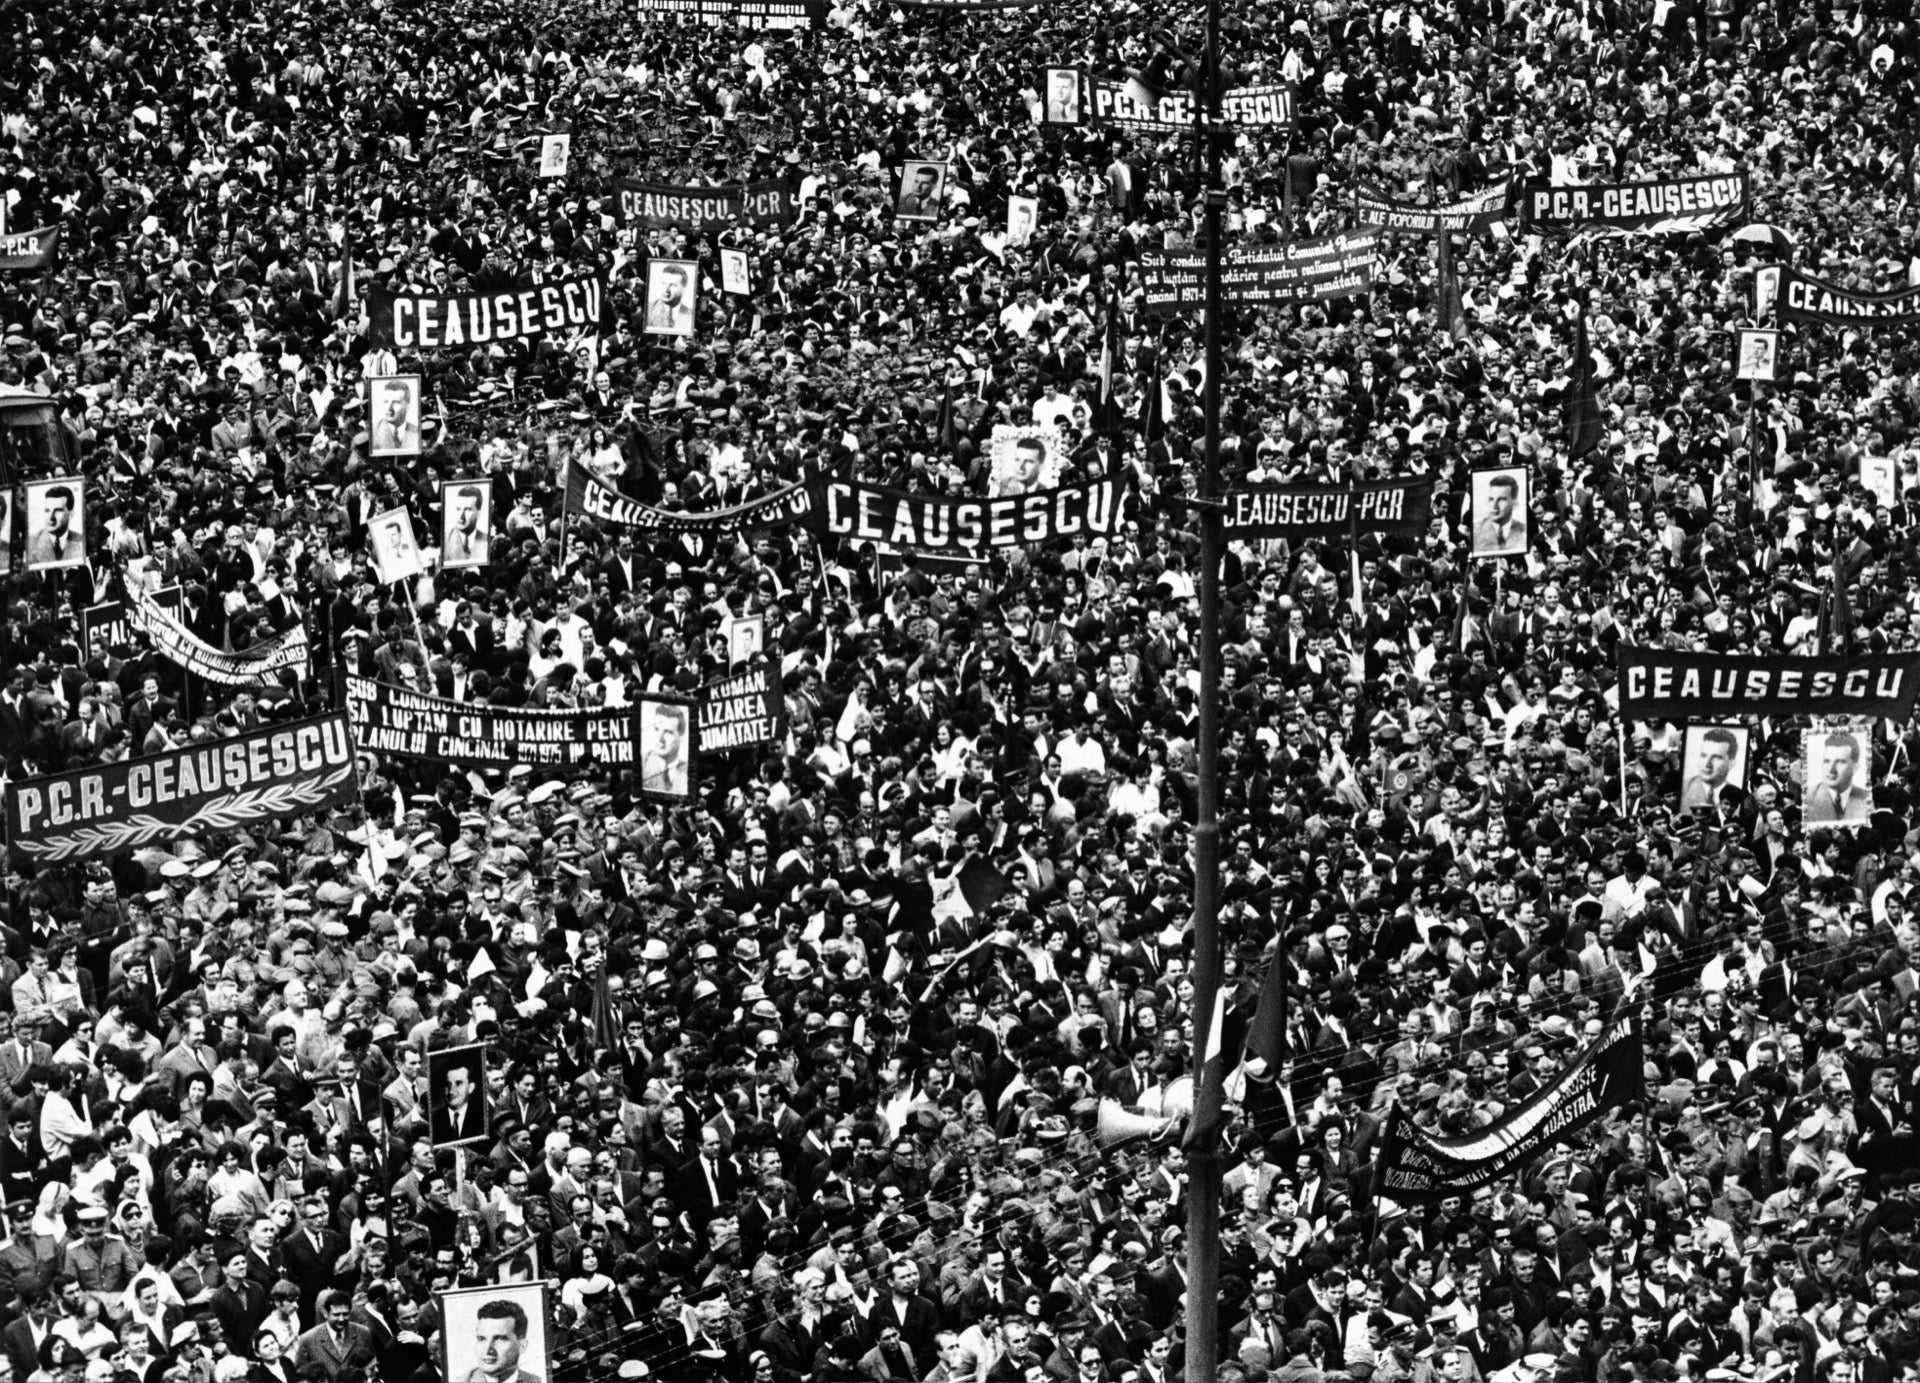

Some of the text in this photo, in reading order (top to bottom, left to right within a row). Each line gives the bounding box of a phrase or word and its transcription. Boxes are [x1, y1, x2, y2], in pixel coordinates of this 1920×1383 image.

[1141, 252, 1165, 267] Sub
[381, 705, 448, 733] LUPTAM
[459, 716, 482, 738] CU
[493, 719, 575, 741] HOTARIRE
[587, 717, 630, 741] PENT
